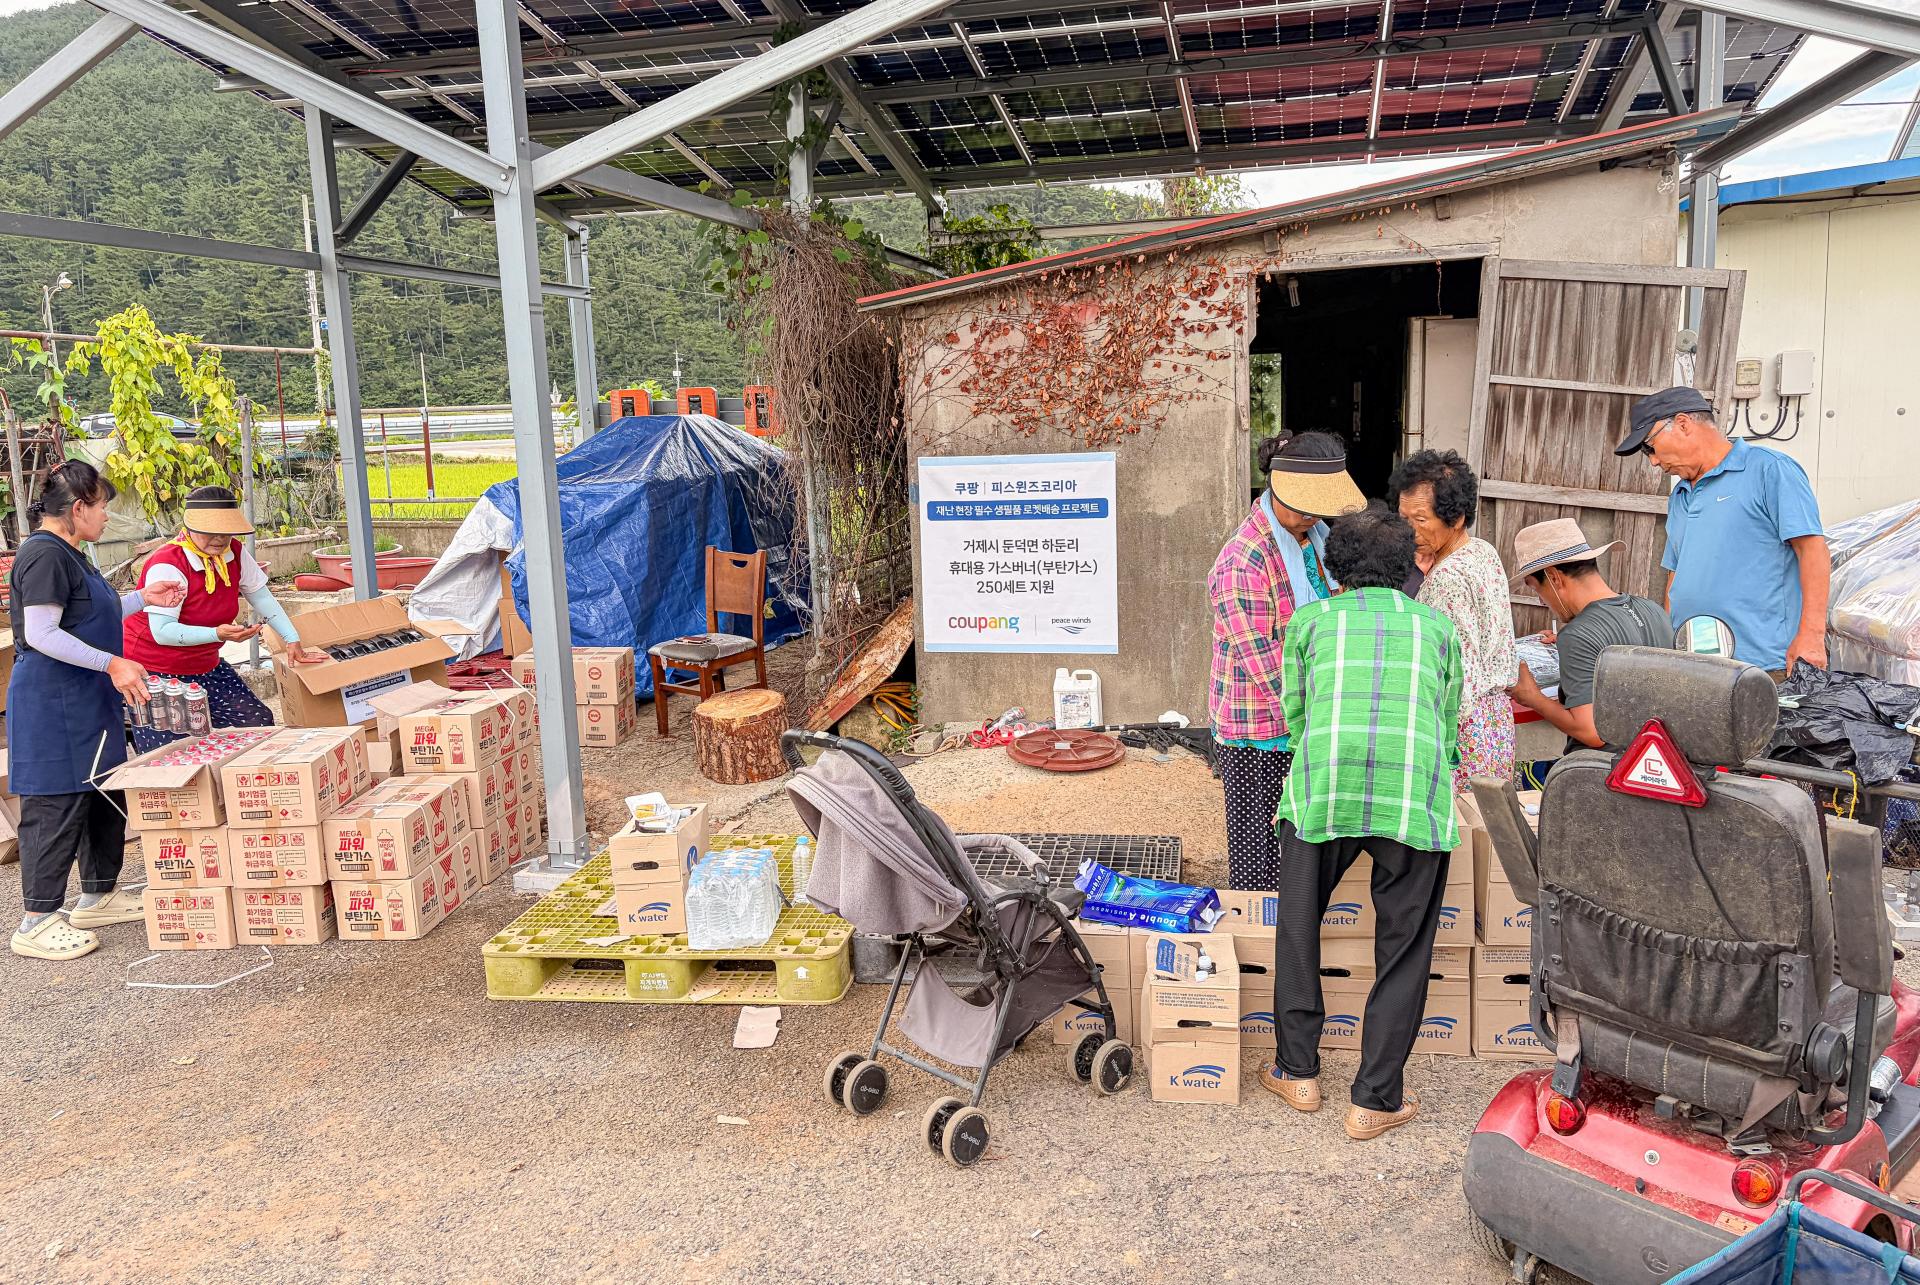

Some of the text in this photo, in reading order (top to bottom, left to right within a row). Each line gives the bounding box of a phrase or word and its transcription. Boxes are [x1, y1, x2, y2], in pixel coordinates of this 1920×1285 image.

[954, 480, 1078, 495] 쿠팡 피스윈즈코리아
[936, 502, 1100, 516] 재난 현장 필수 생필품 로켓배송 프로젝트
[963, 538, 1079, 554] 거제시 둔덕면 하둔리
[948, 559, 1098, 576] 휴대용 가스버너(부탄가스)
[976, 580, 1054, 594] 250세트 지원
[948, 616, 1020, 634] coupang
[1051, 618, 1070, 626] peace
[480, 722, 492, 740] 파워
[414, 732, 437, 745] 파워
[410, 746, 444, 756] 부탄가스
[1640, 774, 1668, 786] 케어라인
[138, 792, 166, 800] 화기엄금
[238, 790, 266, 799] 화기엄금
[140, 800, 168, 808] 취급주의
[240, 799, 268, 808] 취급주의
[434, 819, 446, 838] 파워
[338, 838, 364, 850] 파워
[159, 844, 186, 859] 파워
[244, 850, 272, 859] 화기엄금
[334, 852, 372, 862] 부탄가스
[154, 859, 195, 870] 부탄가스
[246, 860, 274, 868] 취급주의
[444, 876, 456, 896] 파워
[1087, 876, 1102, 900] Double
[348, 898, 375, 910] 파워
[248, 917, 274, 925] 취급주의
[344, 912, 382, 922] 부탄가스
[628, 912, 668, 923] K water
[1129, 912, 1136, 920] A
[1140, 914, 1177, 928] Double
[1322, 916, 1358, 925] water
[158, 922, 186, 930] 취급주의
[1438, 921, 1456, 930] ter
[1504, 917, 1512, 927] K
[1065, 1020, 1105, 1030] K wate
[1240, 1024, 1274, 1034] water
[1321, 1026, 1356, 1036] water
[1417, 1029, 1452, 1039] water
[1495, 1034, 1504, 1044] K
[1170, 1075, 1221, 1088] K water
